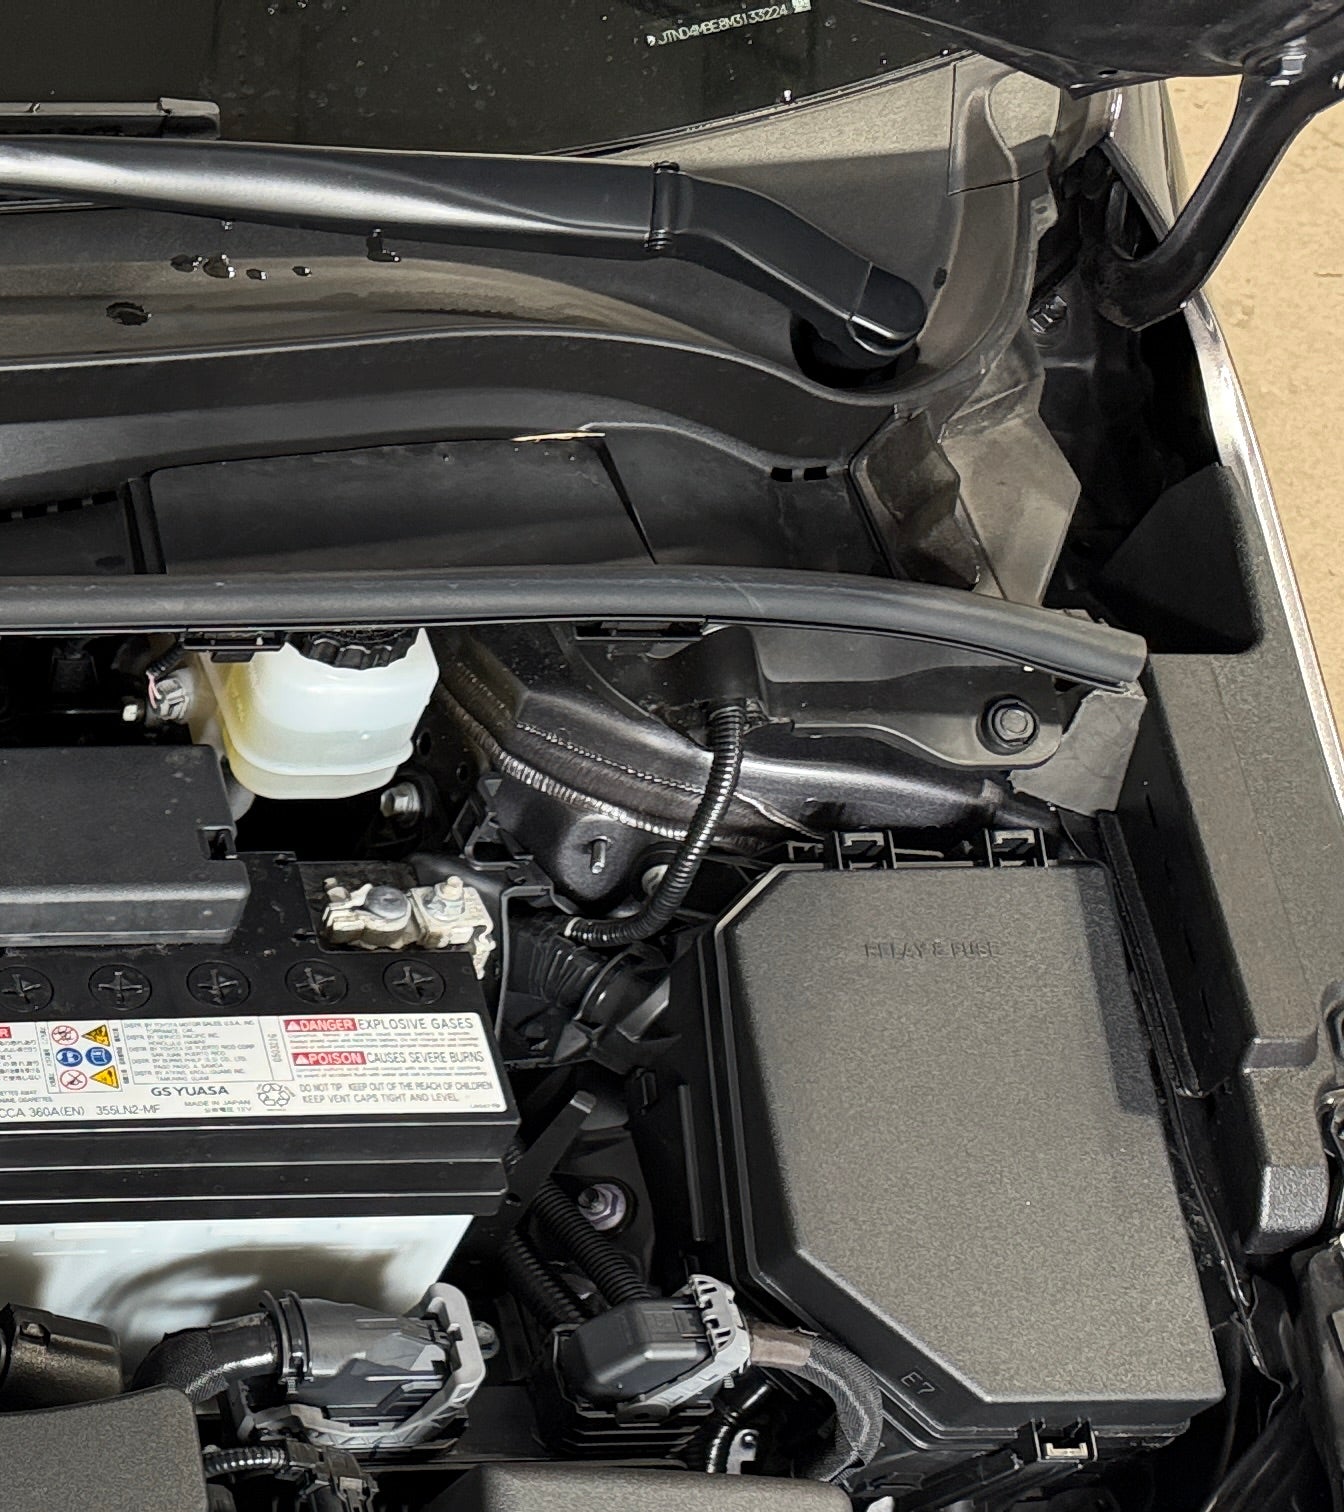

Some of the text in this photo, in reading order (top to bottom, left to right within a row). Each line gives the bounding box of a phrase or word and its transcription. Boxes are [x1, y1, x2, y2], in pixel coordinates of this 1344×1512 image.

[299, 1017, 474, 1031] DANGER EXPLOSIVE GASES
[309, 1051, 485, 1065] POISON CAUSES SEVERE BURNS
[175, 1085, 230, 1096] YUASA
[348, 1083, 367, 1091] KEEP
[302, 1095, 324, 1104] KEEP
[28, 1106, 85, 1118] 360A(EN)
[95, 1104, 161, 1115] 355LN2-MF
[901, 1371, 936, 1395] E7
